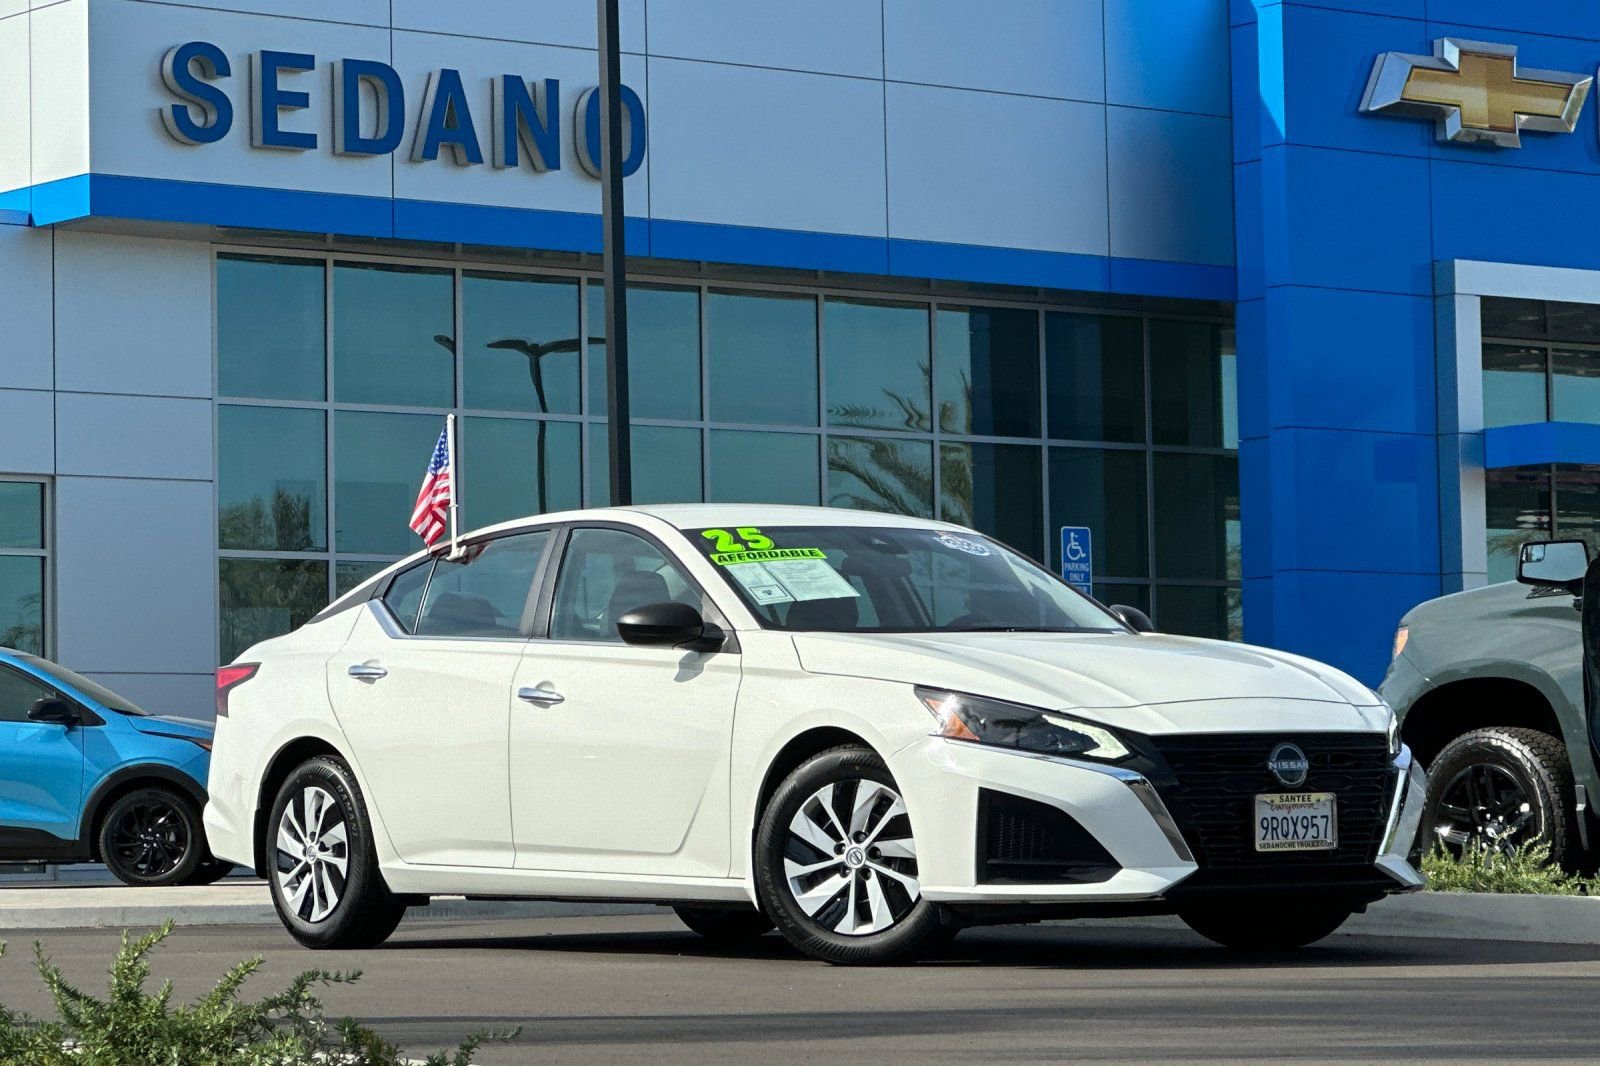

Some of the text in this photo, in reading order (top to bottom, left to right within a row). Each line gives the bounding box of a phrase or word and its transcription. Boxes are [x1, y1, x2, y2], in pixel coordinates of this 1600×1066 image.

[160, 41, 646, 180] SEDANO
[702, 527, 774, 552] 25
[717, 548, 819, 563] AFFORDABLE
[1064, 562, 1089, 572] PARKING
[1070, 572, 1085, 582] ONLY
[1268, 761, 1309, 770] NISSAN
[1279, 794, 1312, 803] SANTEE
[1260, 814, 1329, 841] 9RQX957
